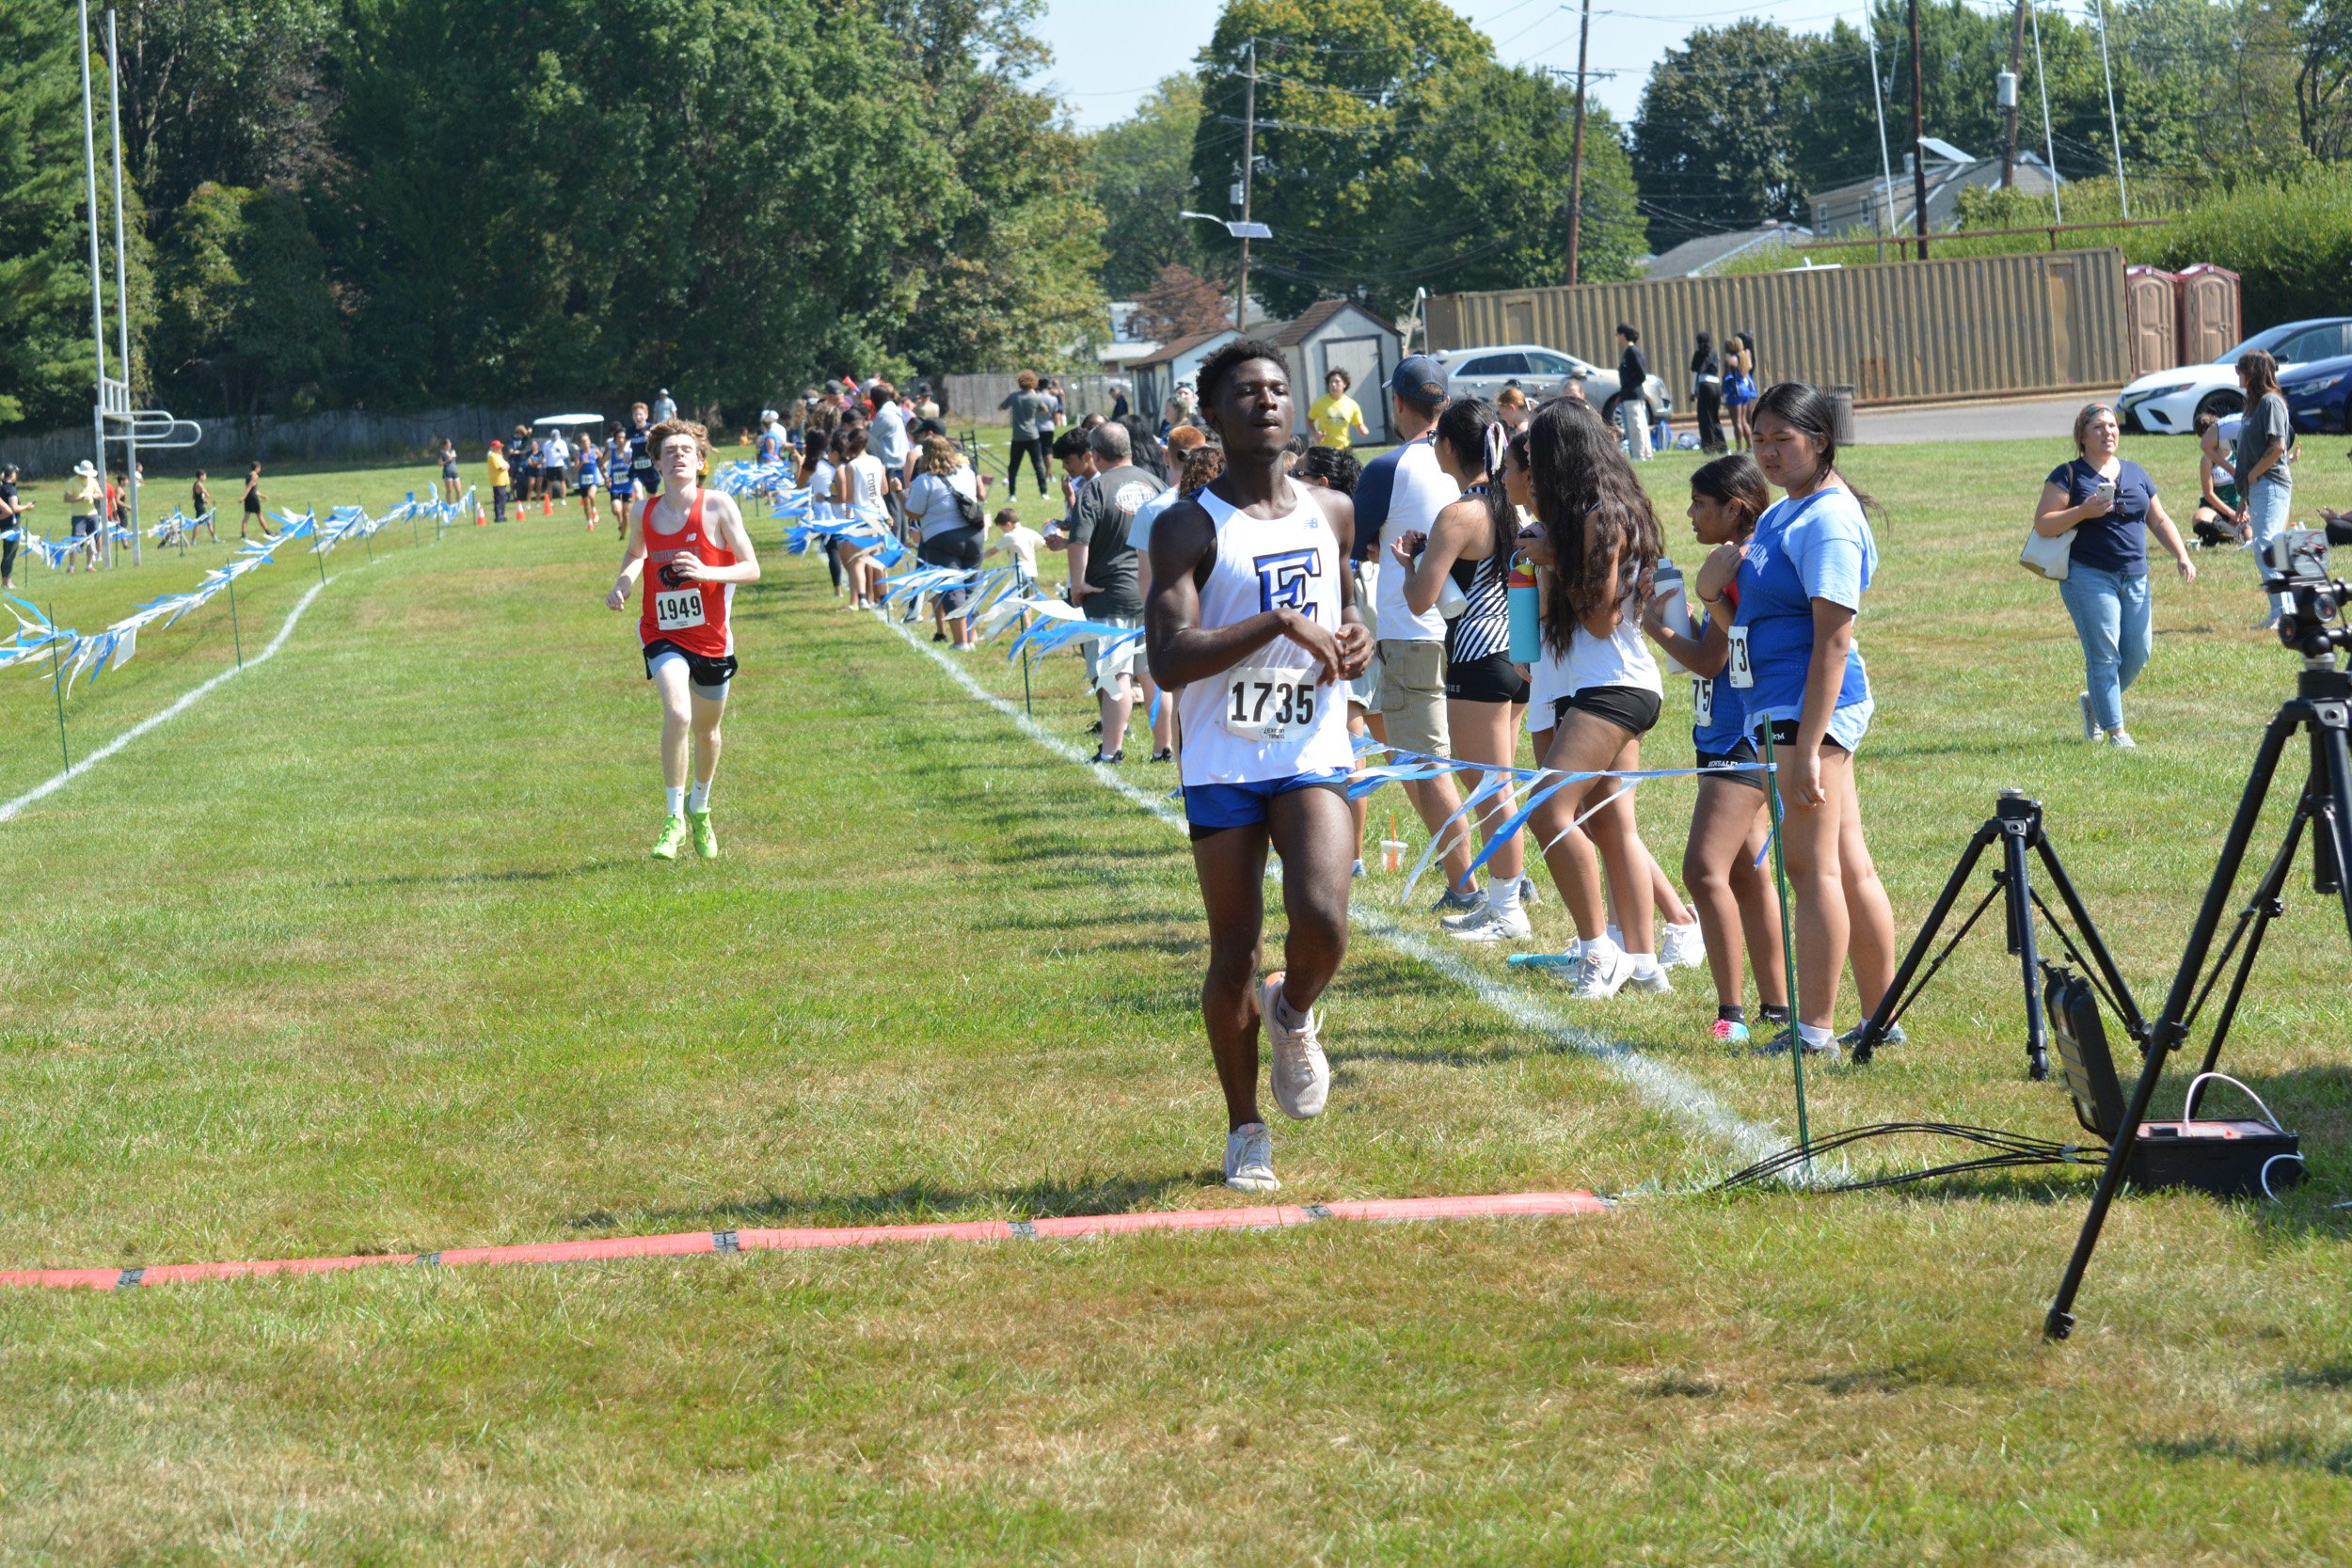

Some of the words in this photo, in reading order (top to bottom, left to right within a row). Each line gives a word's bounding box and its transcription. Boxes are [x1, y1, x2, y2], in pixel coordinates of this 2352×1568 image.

[658, 595, 702, 621] 1949
[1728, 638, 1748, 673] 73
[1231, 681, 1315, 725] 1735
[1692, 679, 1711, 712] 75
